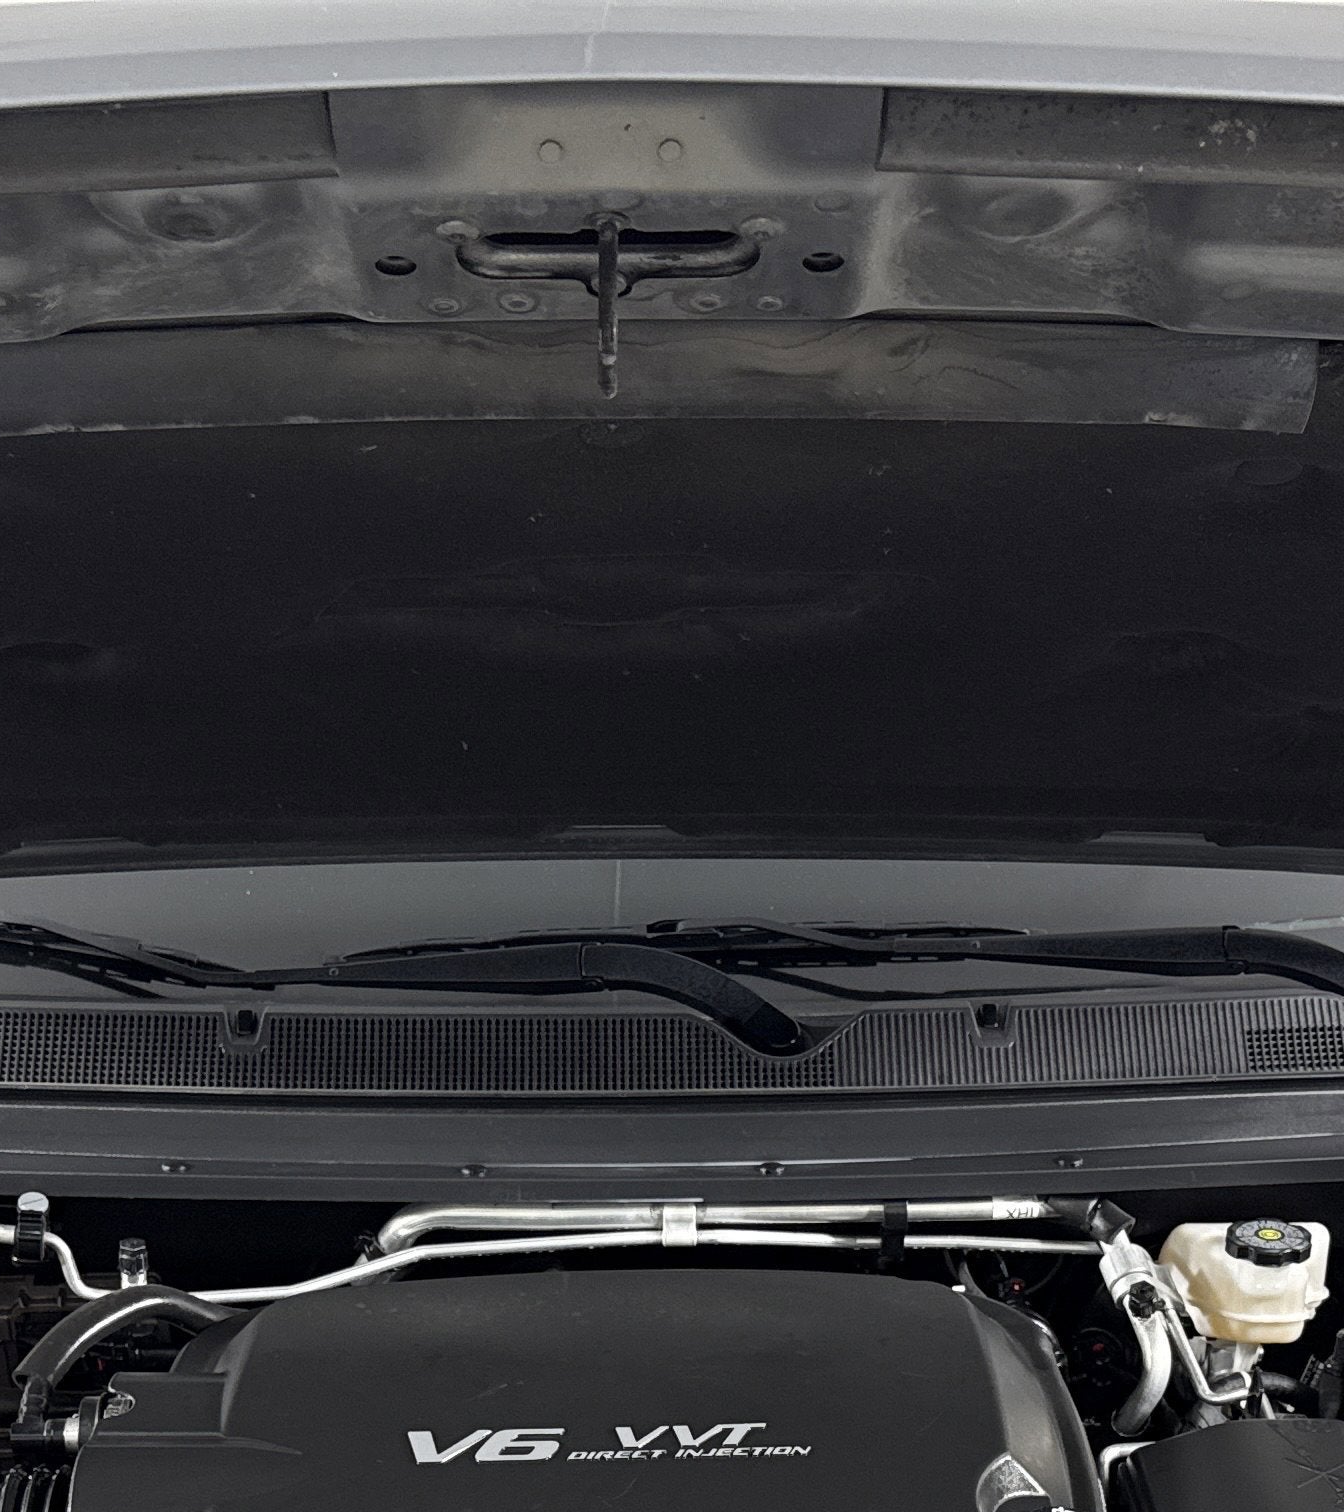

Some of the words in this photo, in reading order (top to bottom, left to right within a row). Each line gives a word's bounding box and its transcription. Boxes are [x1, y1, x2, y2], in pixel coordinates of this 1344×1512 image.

[406, 1428, 566, 1465] V6
[614, 1422, 768, 1449] VVT
[566, 1448, 667, 1462] DIRECT
[674, 1444, 813, 1459] INJECTION
